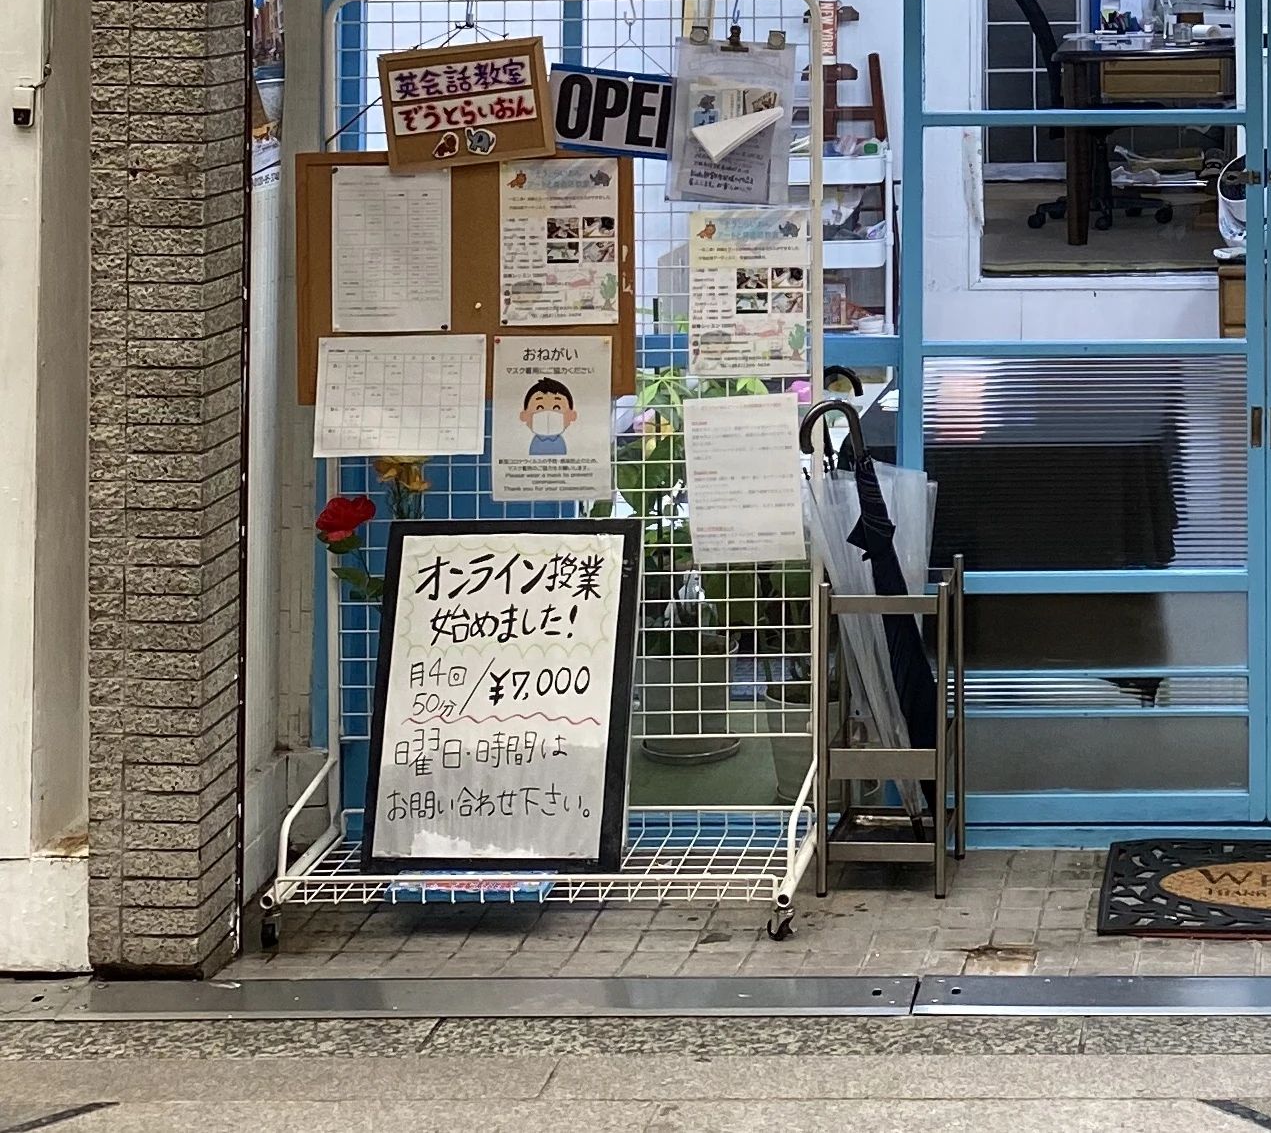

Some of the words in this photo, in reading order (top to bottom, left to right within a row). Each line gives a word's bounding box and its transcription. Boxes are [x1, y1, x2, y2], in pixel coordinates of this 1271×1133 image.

[820, 2, 834, 22] NEW
[822, 26, 834, 54] YORK
[395, 59, 526, 96] 英会話教室
[398, 96, 534, 131] ぞうとらいおん
[523, 348, 578, 361] おねがい
[415, 553, 605, 600] オンライン授業
[431, 604, 579, 645] 始めました!
[410, 658, 467, 688] 月4回
[490, 666, 591, 706] ¥7,000
[412, 693, 457, 717] 50分
[394, 728, 568, 777] 曜日・時間は
[387, 783, 591, 821] お問い合わせ下さい。
